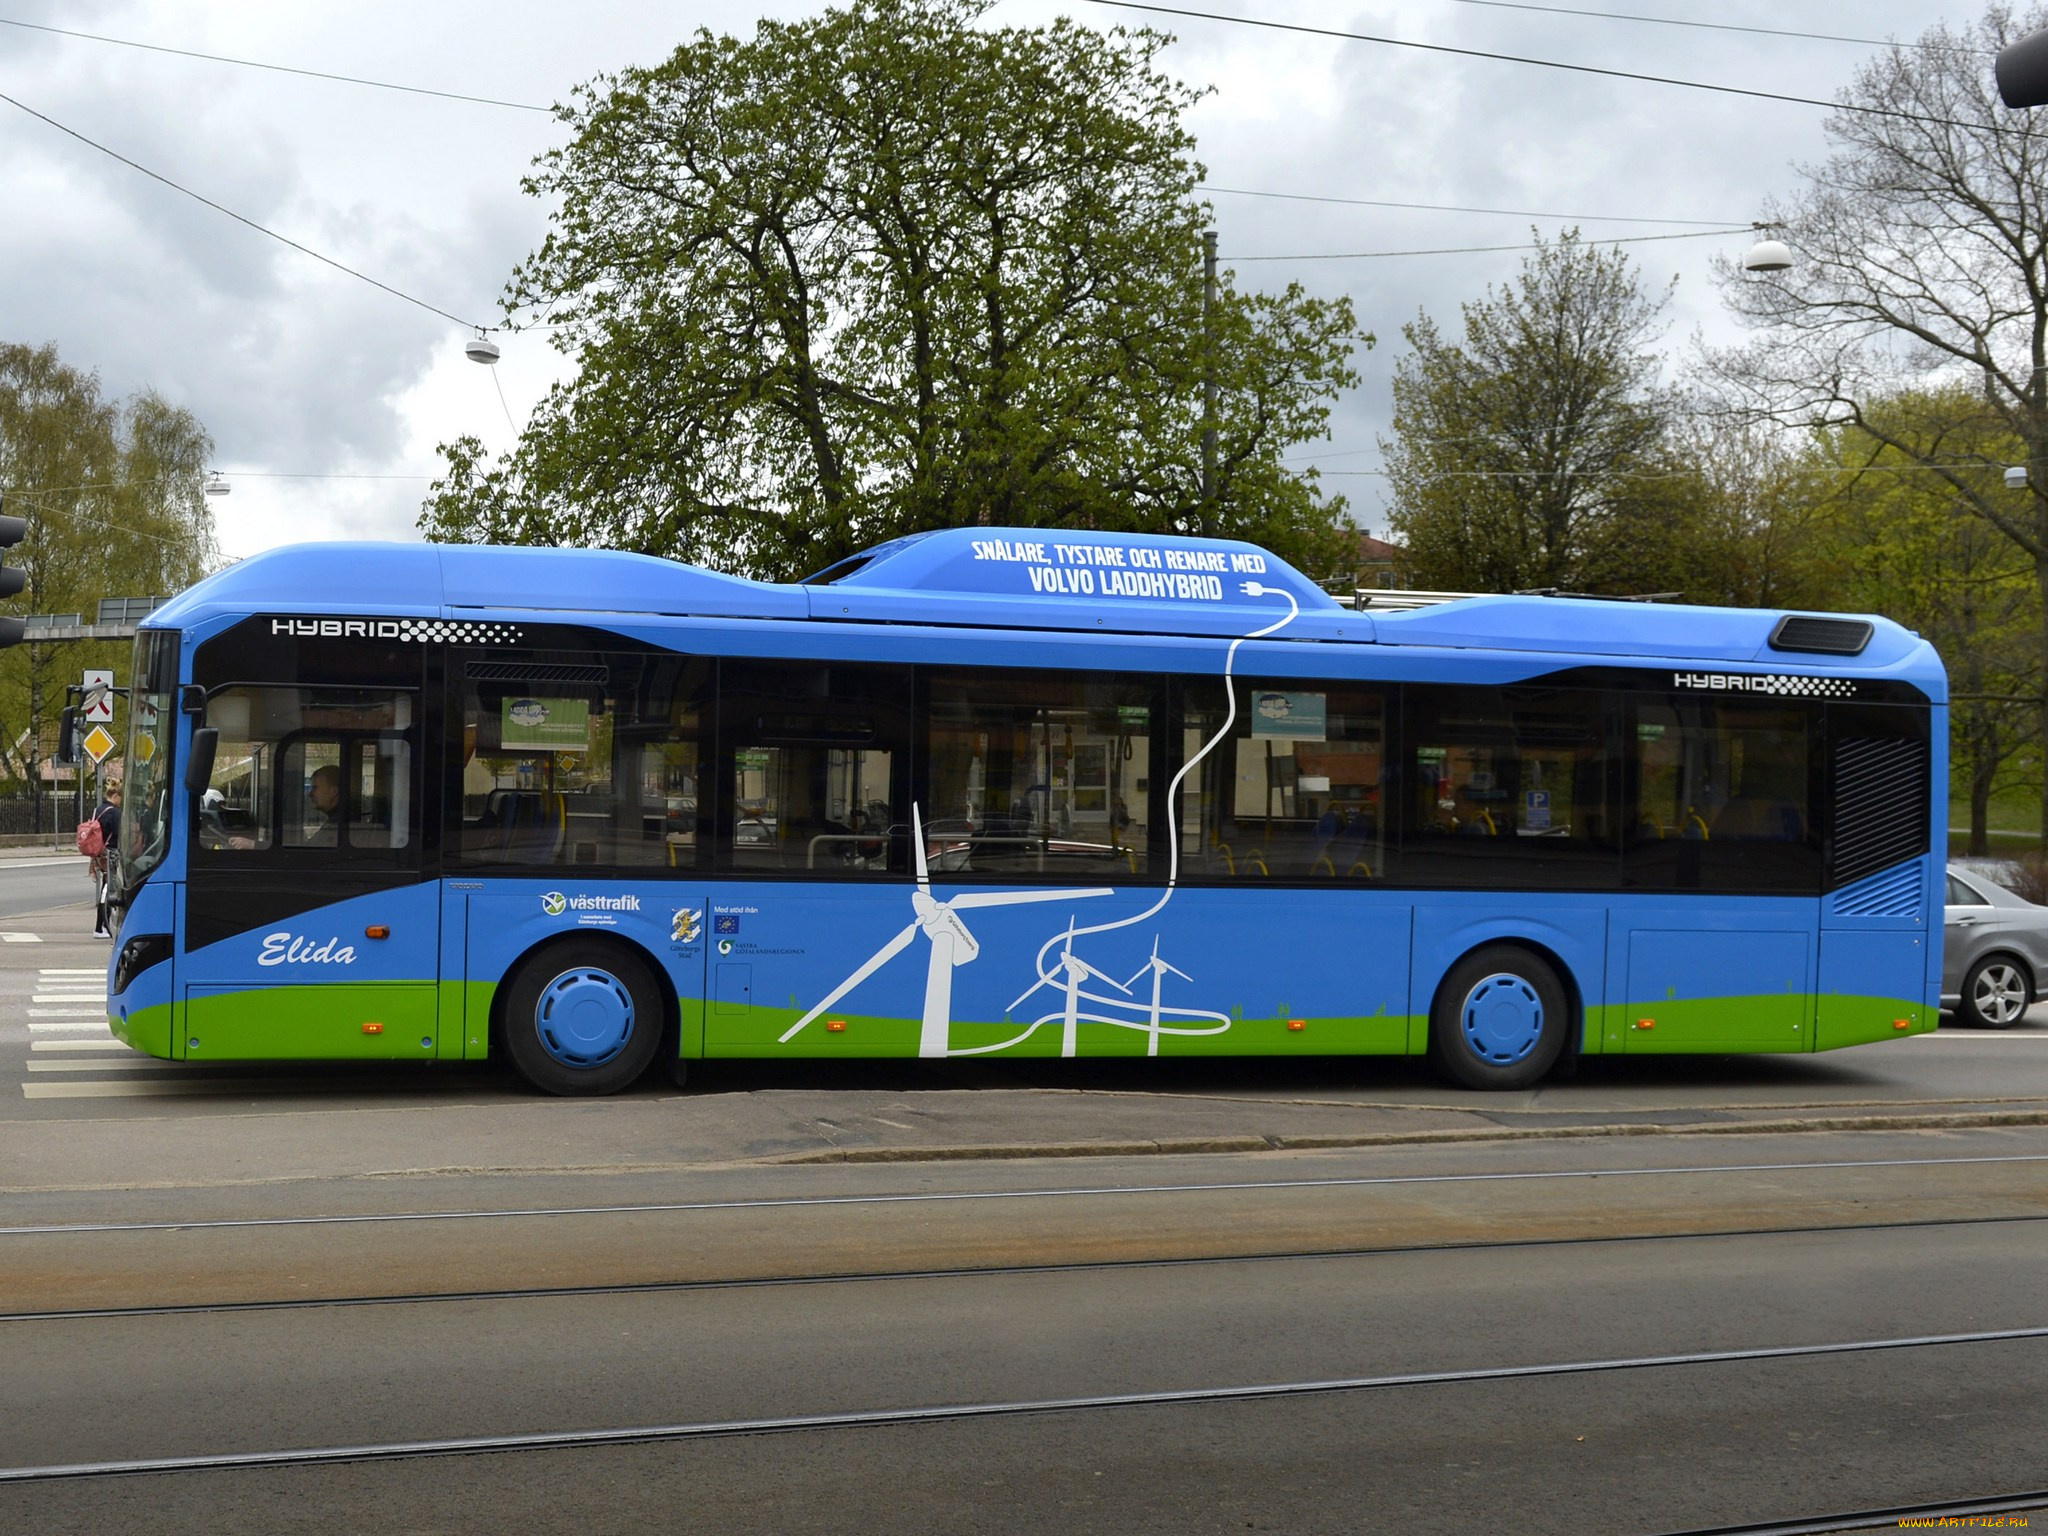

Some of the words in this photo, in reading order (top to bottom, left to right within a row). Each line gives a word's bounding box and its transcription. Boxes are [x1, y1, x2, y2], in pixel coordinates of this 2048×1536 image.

[971, 539, 1052, 565] SNÅLARE,
[1054, 544, 1126, 567] TYSTARE
[1130, 548, 1161, 569] OCH
[1166, 550, 1229, 573] RENARE
[1232, 554, 1267, 575] MED
[1028, 567, 1095, 595] VOLVO
[1099, 570, 1222, 601] LADDHYBRID
[271, 618, 399, 638] HYBRID
[1674, 673, 1767, 692] HYBRID
[569, 894, 641, 911] västtrafik
[257, 932, 358, 967] Elida
